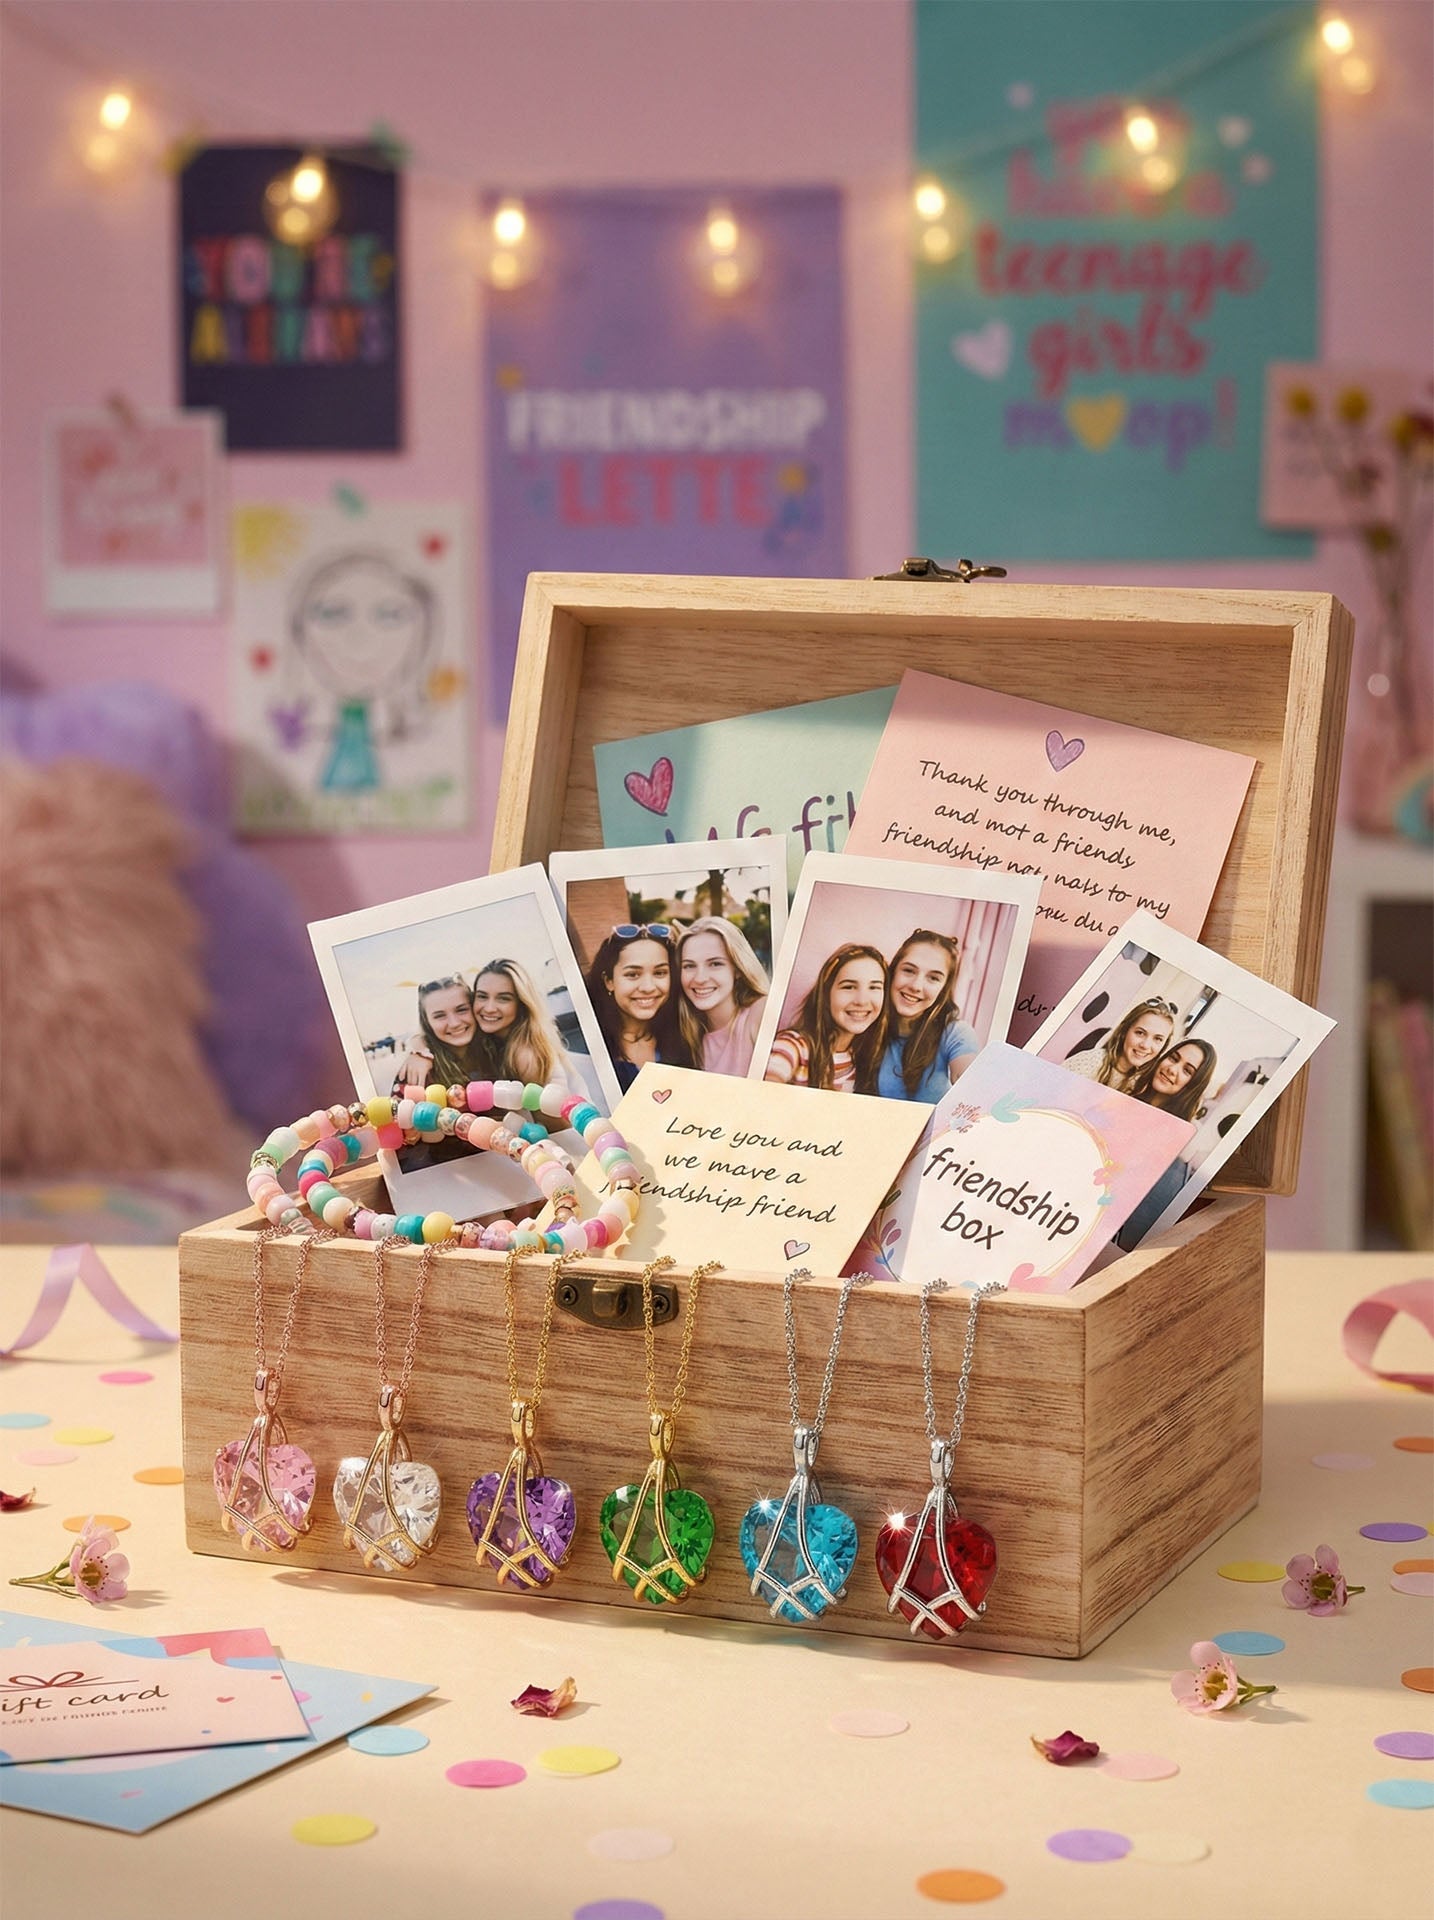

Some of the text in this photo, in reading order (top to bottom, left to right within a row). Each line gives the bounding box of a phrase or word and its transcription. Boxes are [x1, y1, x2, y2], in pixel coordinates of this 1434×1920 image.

[974, 220, 1268, 320] teenage
[1028, 303, 1212, 399] girls
[919, 760, 1177, 847] Thank you through me,
[934, 805, 979, 826] and
[1033, 830, 1049, 844] a
[1052, 832, 1136, 869] friends
[882, 823, 1002, 871] friendship
[1107, 884, 1132, 903] to
[1136, 896, 1170, 919] my
[664, 1153, 808, 1185] we mave a
[666, 1116, 843, 1158] Love you and
[746, 1194, 837, 1224] friend
[921, 1146, 1081, 1242] friendship
[940, 1200, 1005, 1250] box
[68, 1684, 170, 1706] card
